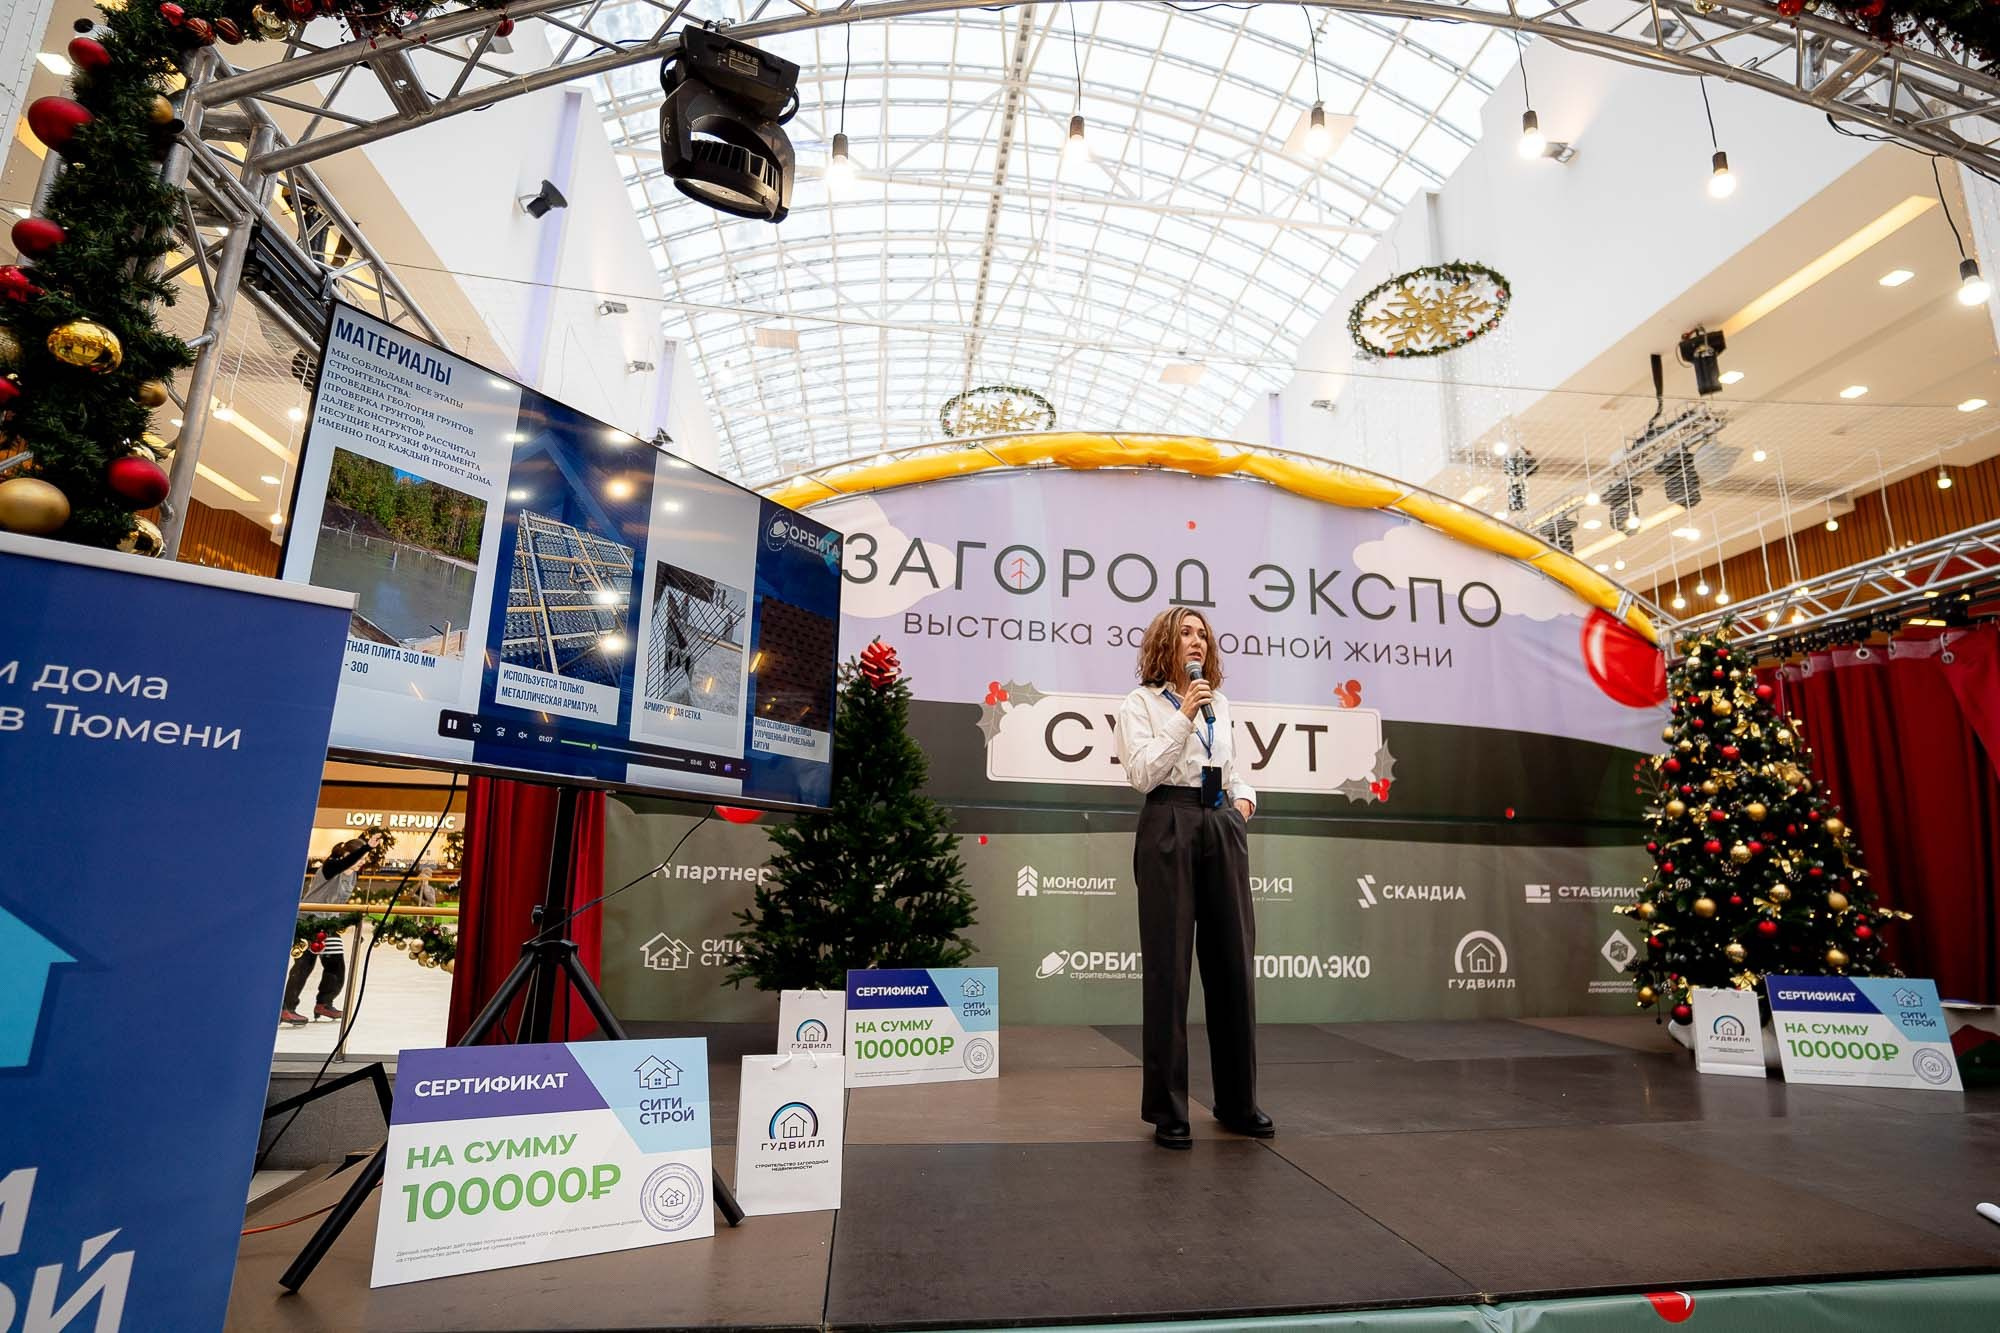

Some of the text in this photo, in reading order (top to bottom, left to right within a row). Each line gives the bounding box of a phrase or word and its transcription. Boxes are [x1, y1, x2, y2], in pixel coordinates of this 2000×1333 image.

[335, 317, 452, 386] МАТЕРИАЛЫ
[329, 360, 412, 399] СТРОИТЕЛЬСТВА:
[331, 348, 464, 409] МЫ СОБЛЮДАЕМ ВСЕ ЭТАПЫ
[324, 382, 378, 409] (ПРОВЕРКА
[326, 370, 474, 436] ПРОВЕДЕНА ГЕОЛОГИЯ ГРУНТОВ
[321, 393, 476, 458] ДАЛЕЕ КОНСТРУКТОР РАССЧИТАЛ
[317, 416, 364, 438] ИМЕННО
[365, 434, 386, 448] ПОД
[388, 442, 430, 464] КАЖДЫЙ
[432, 458, 465, 475] ПРОЕКТ
[319, 405, 481, 471] НЕСУЩИЕ НАГРУЗКИ ФУНДАМЕНТА
[790, 526, 839, 558] ОРБИТА
[842, 532, 1502, 628] ЗАГОРОД ЭКСПО
[351, 661, 369, 673] 300
[371, 645, 401, 660] ПЛИТА
[403, 652, 419, 665] 300
[421, 655, 436, 668] ММ
[32, 664, 169, 700] дома
[503, 669, 585, 694] ИСПОЛЬЗУЕТСЯ ТОЛЬКО
[501, 686, 562, 707] МЕТАЛЛИЧЕСКАЯ
[46, 703, 242, 750] Тюмени
[753, 740, 770, 750] БИТУМ
[346, 812, 456, 829] LOVE REPUBLIC
[1043, 877, 1117, 889] МОНОЛИТ
[1382, 885, 1467, 901] СКАНДИА
[1070, 972, 1126, 980] строительная
[1448, 978, 1516, 991] ГУДВИЛЛ
[856, 986, 929, 997] СЕРТИФИКАТ
[1778, 990, 1856, 1003] СЕРТИФИКАТ
[963, 1008, 991, 1017] СТРОЙ
[1902, 1018, 1937, 1028] СТРОЙ
[855, 1019, 933, 1034] НА СУММУ
[1785, 1022, 1869, 1036] НА СУММУ
[414, 1073, 569, 1097] СЕРТИФИКАТ
[639, 1097, 682, 1112] СИТИ
[639, 1106, 695, 1125] СТРОЙ
[406, 1133, 578, 1170] НА СУММУ
[760, 1140, 825, 1151] ГУДВИЛЛ
